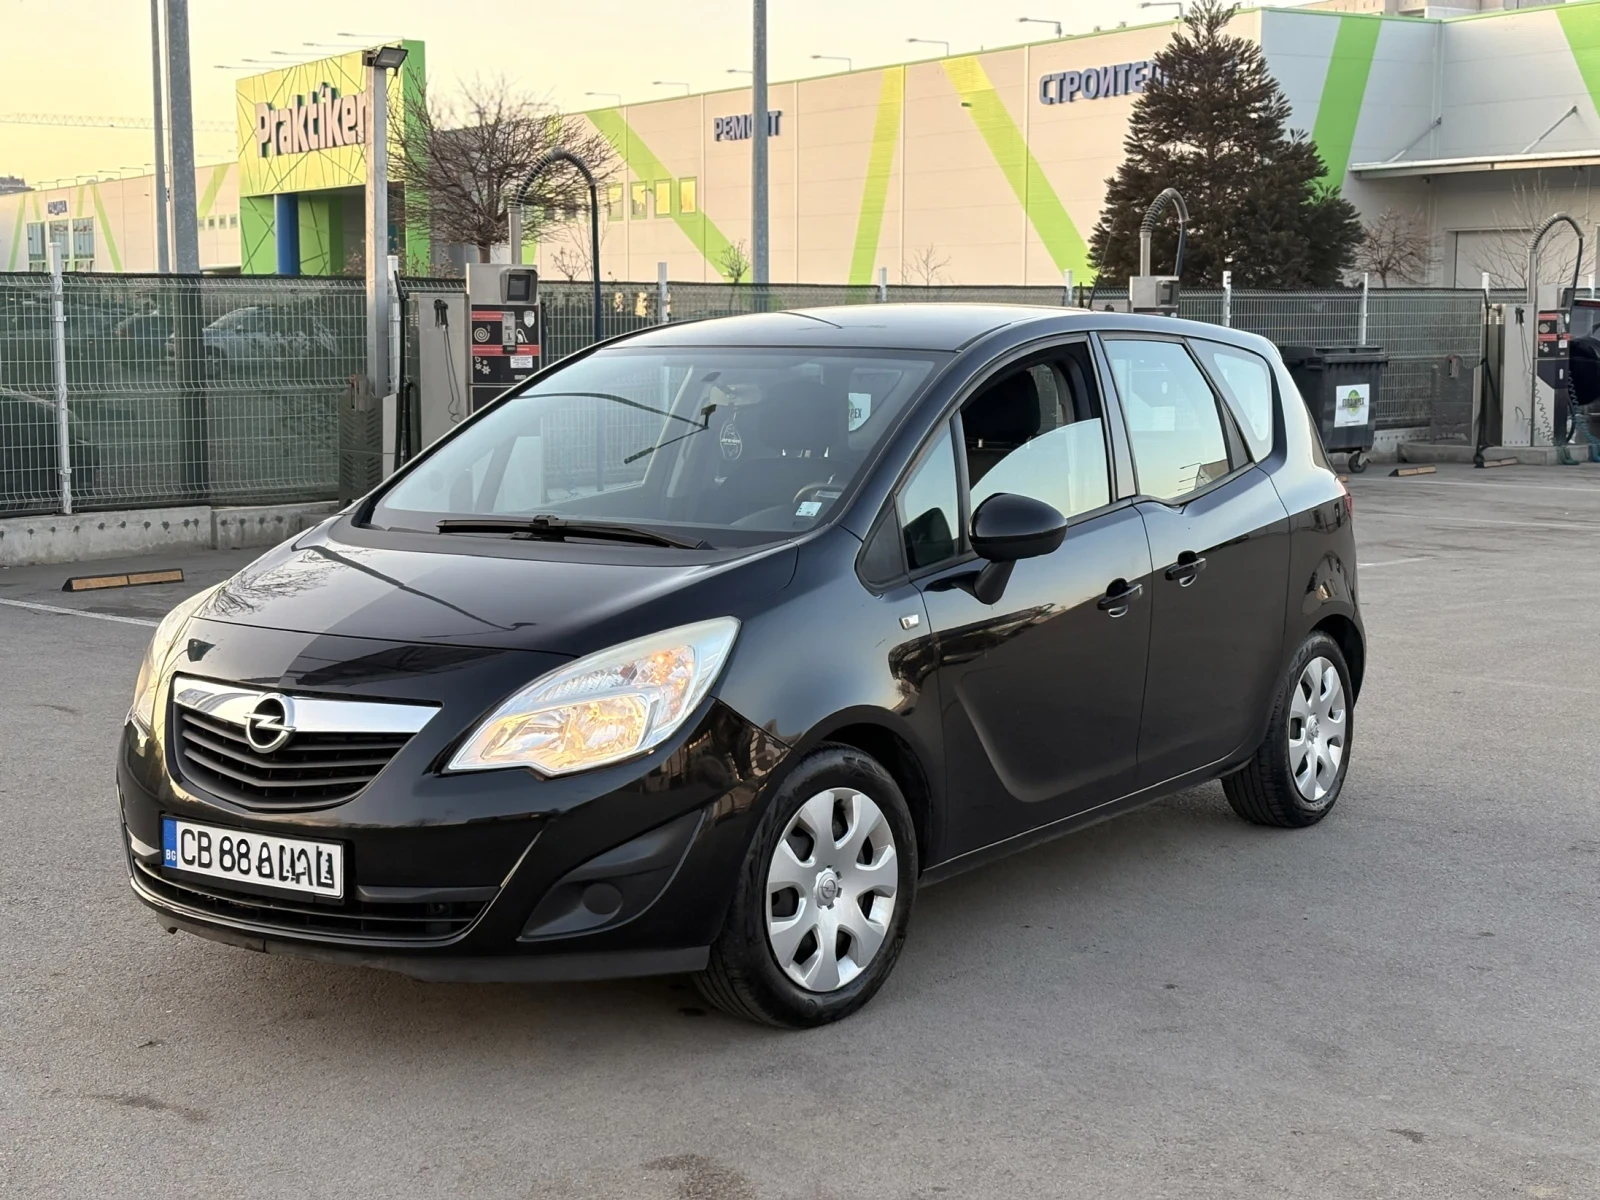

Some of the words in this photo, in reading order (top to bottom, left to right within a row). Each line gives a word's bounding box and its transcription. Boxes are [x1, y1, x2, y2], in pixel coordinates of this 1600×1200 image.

[255, 82, 367, 158] Praktiker
[714, 110, 782, 142] РЕМОТ
[165, 849, 177, 862] BG
